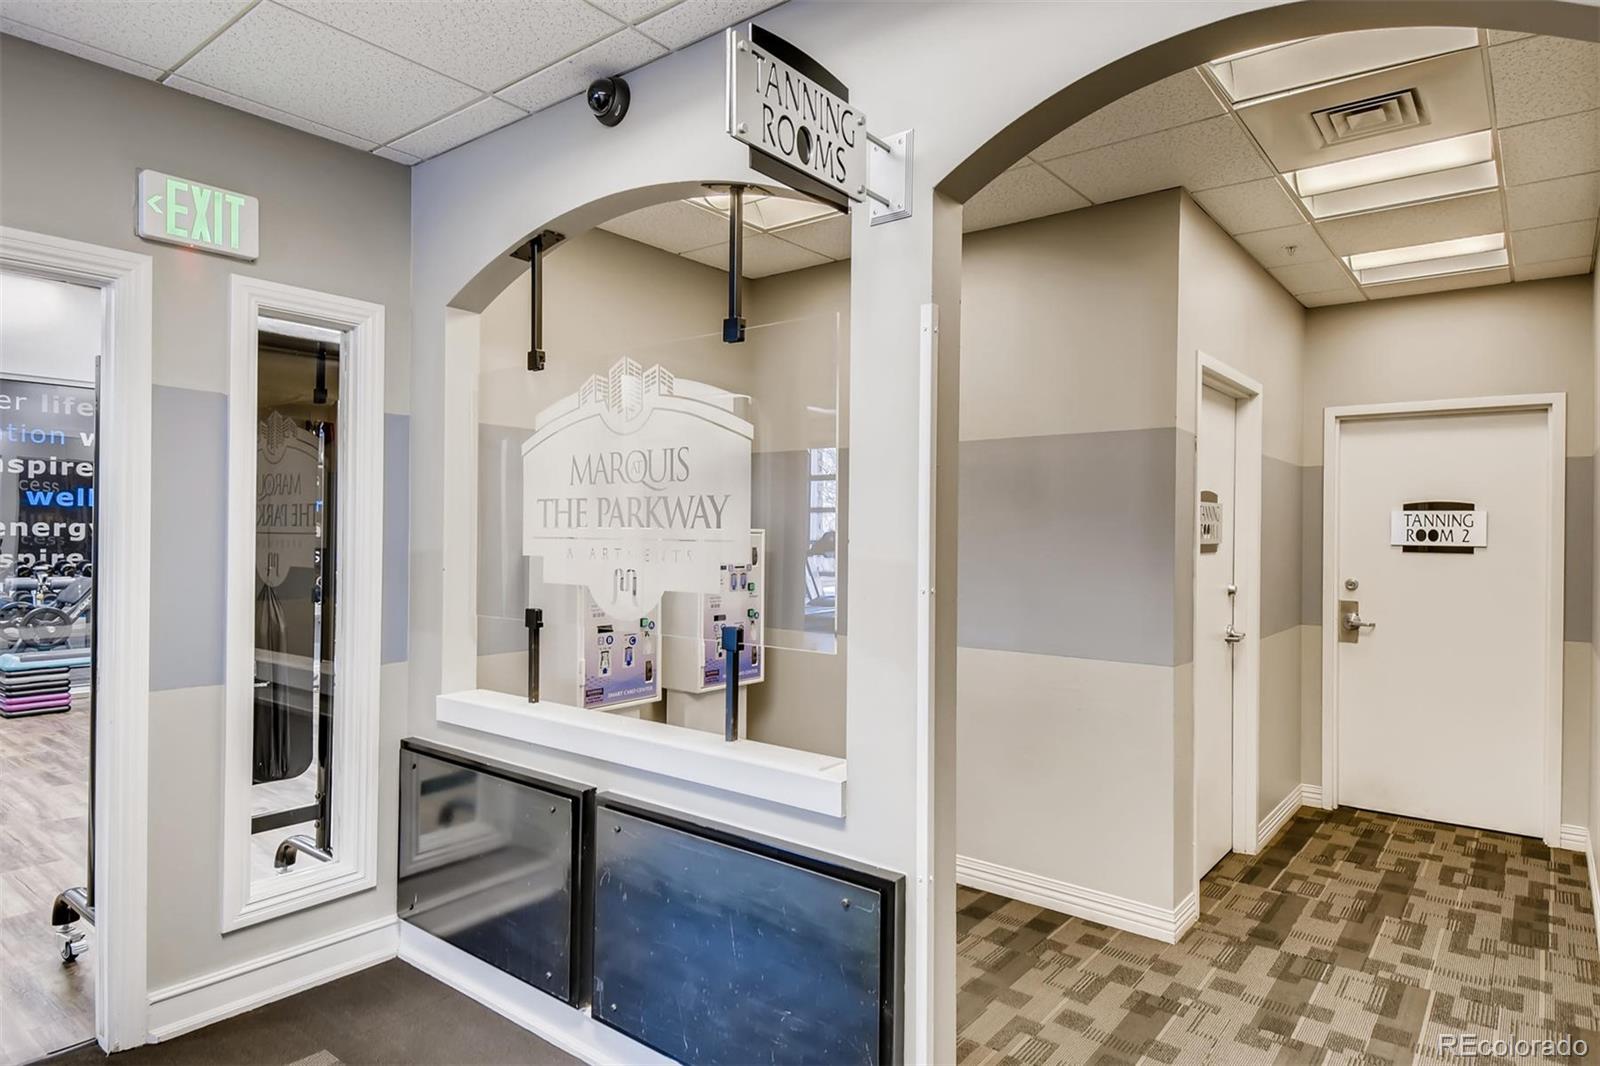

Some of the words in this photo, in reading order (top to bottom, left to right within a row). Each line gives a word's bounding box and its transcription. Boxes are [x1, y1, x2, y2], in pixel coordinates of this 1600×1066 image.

[751, 50, 855, 148] TANNING
[762, 103, 847, 183] ROOMS
[166, 179, 245, 249] EXIT
[41, 393, 94, 417] life
[0, 423, 65, 445] tion
[0, 456, 94, 478] spire
[570, 446, 690, 491] MARQUIS
[537, 498, 588, 529] THE
[597, 494, 732, 529] PARKWAY
[1403, 513, 1474, 528] TANNING
[0, 521, 94, 542] nerg
[1406, 528, 1454, 543] ROOM
[1462, 528, 1470, 543] 2
